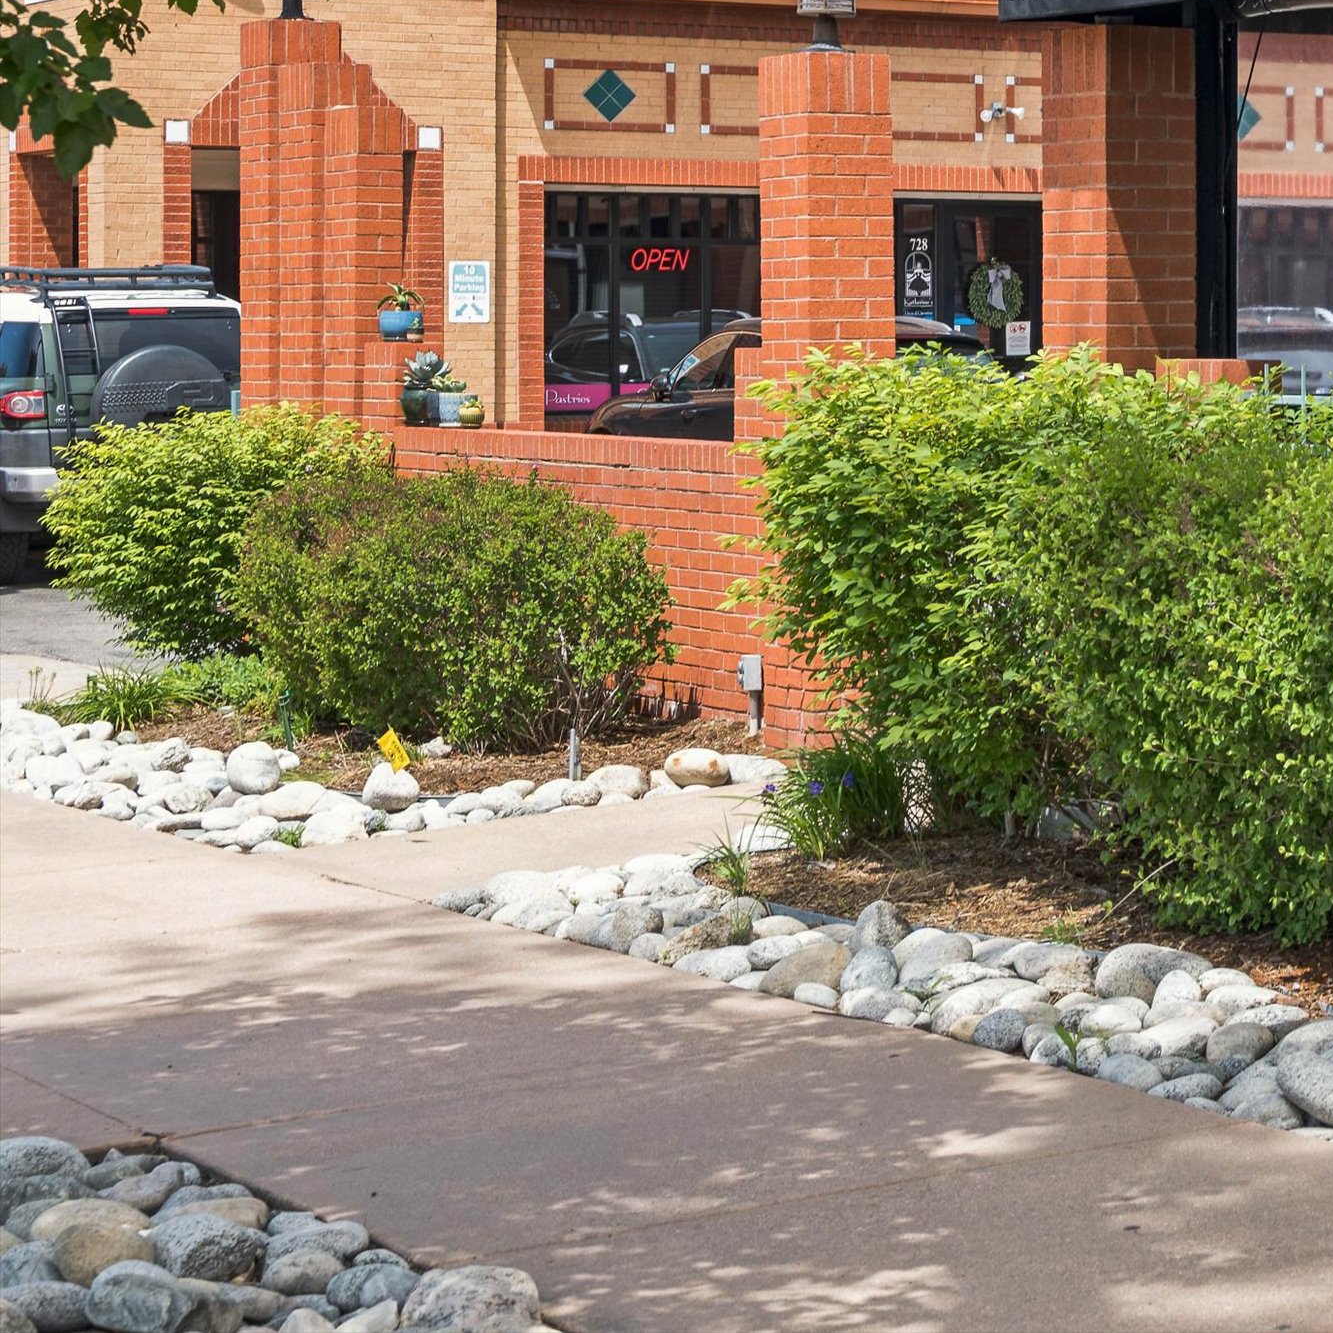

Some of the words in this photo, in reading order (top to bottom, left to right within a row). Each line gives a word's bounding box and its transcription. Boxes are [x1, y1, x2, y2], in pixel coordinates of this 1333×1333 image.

[910, 237, 928, 251] 728
[631, 248, 690, 271] OPEN
[464, 266, 475, 275] 10
[546, 390, 591, 406] Pastries
